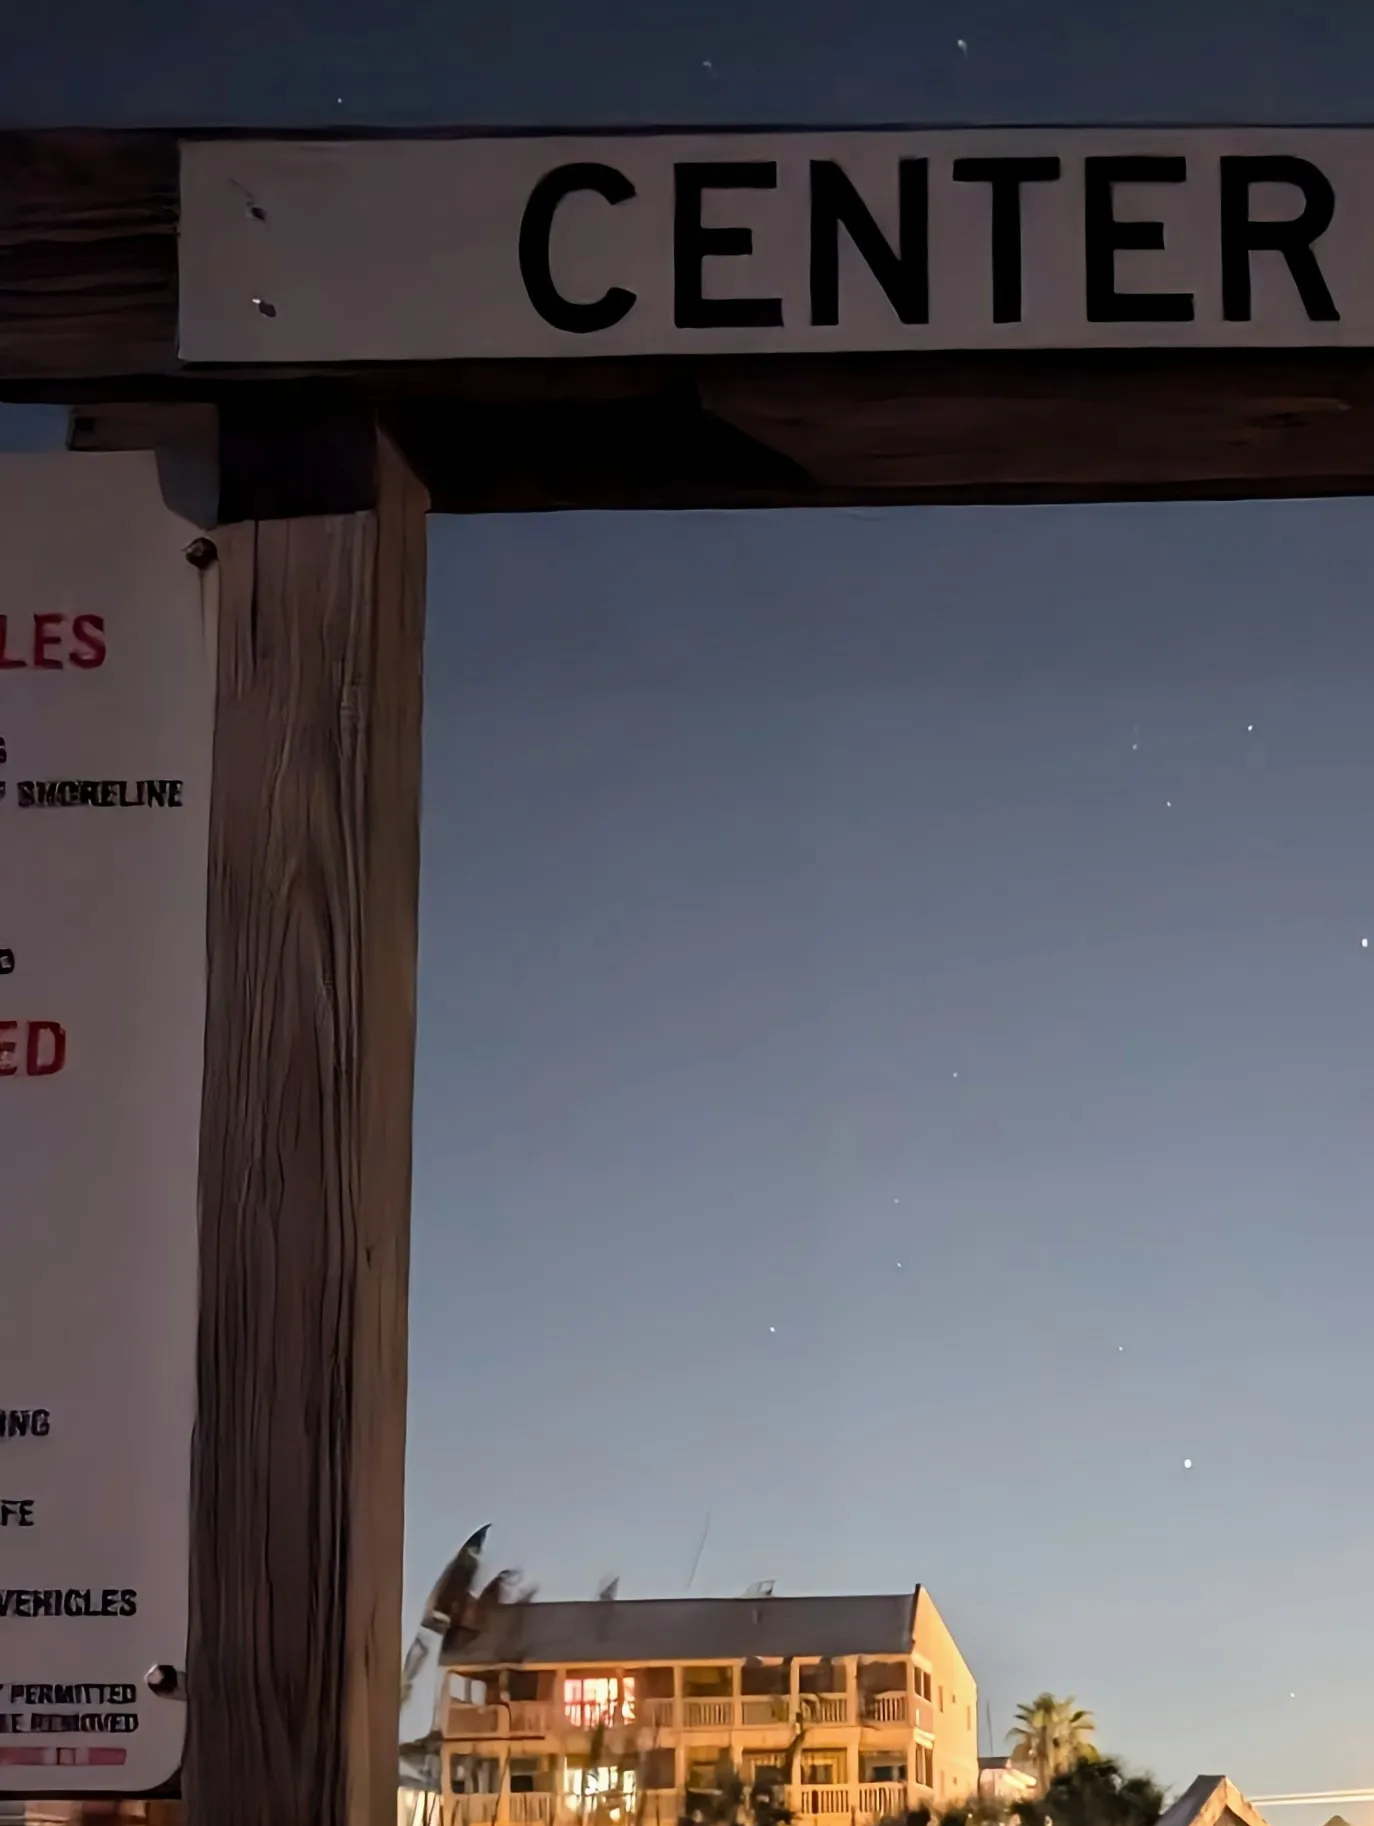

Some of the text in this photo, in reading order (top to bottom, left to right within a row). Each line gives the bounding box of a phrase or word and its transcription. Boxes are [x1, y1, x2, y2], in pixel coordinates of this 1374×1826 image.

[518, 155, 1341, 334] CENTER
[17, 781, 183, 808] SHORELINE
[0, 1590, 138, 1618] VEHICLES
[11, 1684, 137, 1704] PERMITTED
